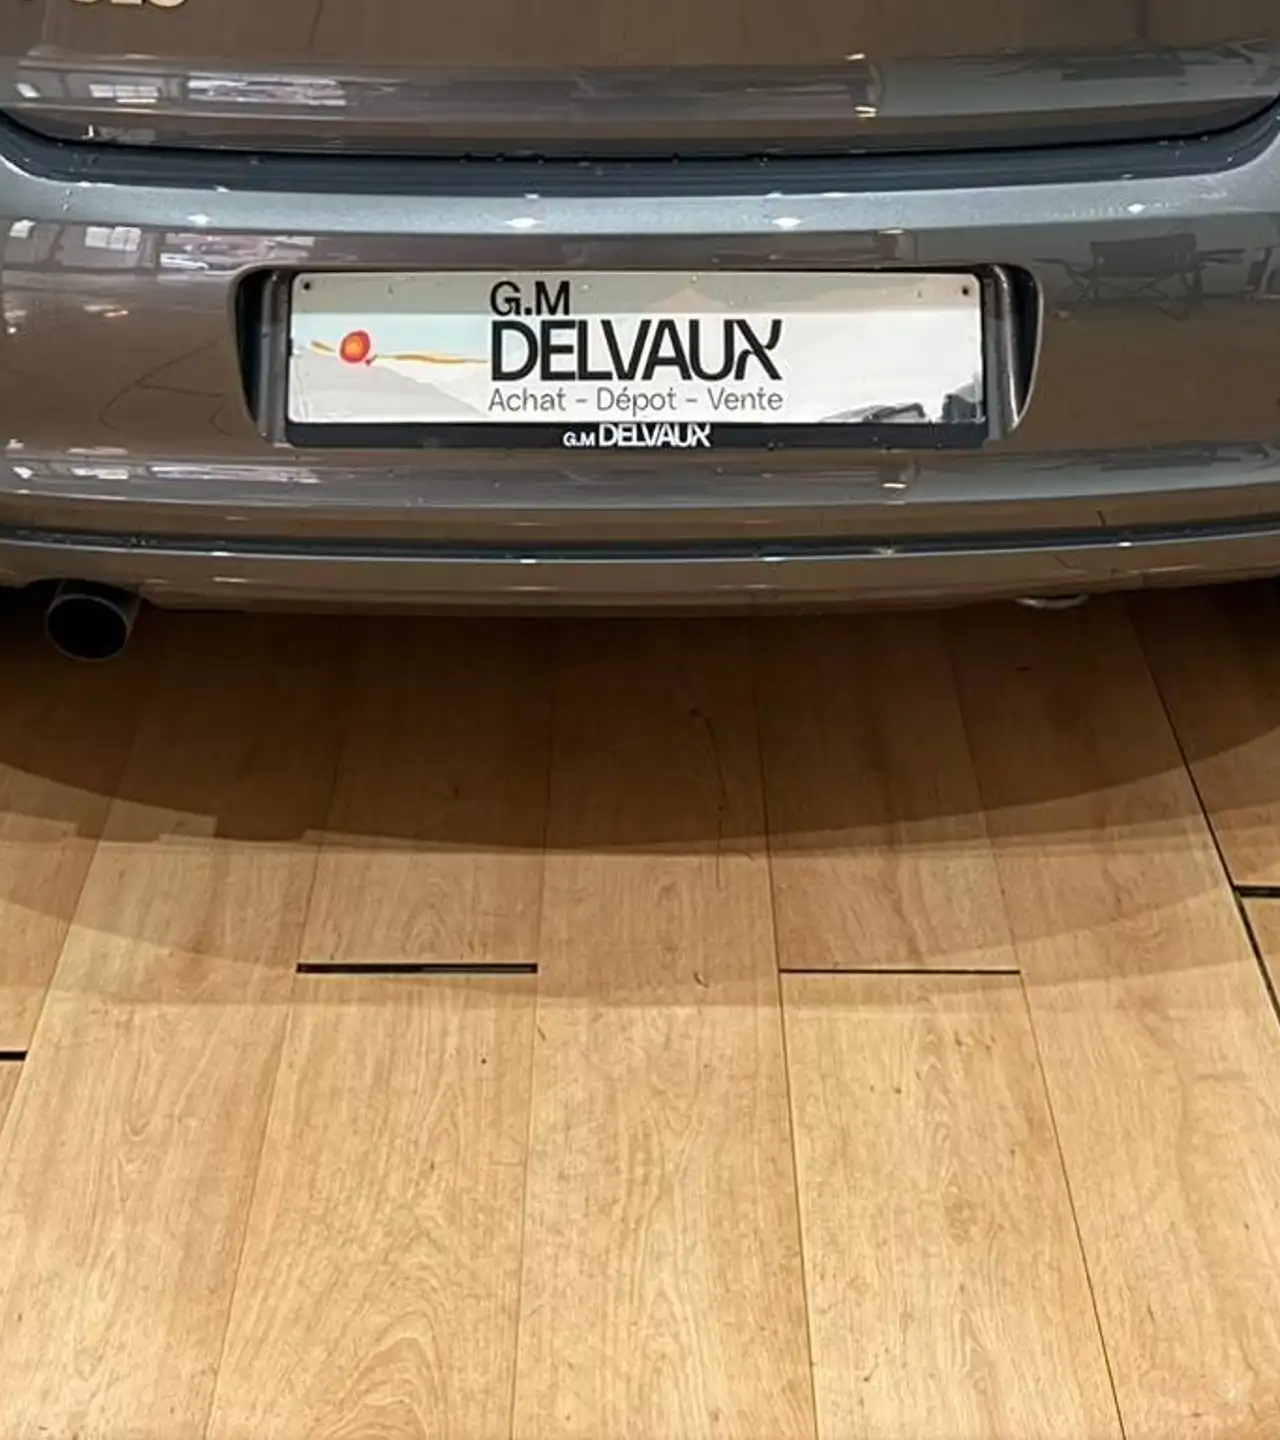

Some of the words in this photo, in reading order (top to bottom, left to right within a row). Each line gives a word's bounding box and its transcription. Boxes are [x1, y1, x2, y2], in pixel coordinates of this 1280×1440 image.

[490, 281, 570, 316] G.M
[491, 319, 783, 381] DELVAUX
[488, 388, 567, 412] Achat
[596, 386, 678, 417] Dépot
[708, 387, 783, 412] Vente
[598, 424, 712, 448] DELVAUX
